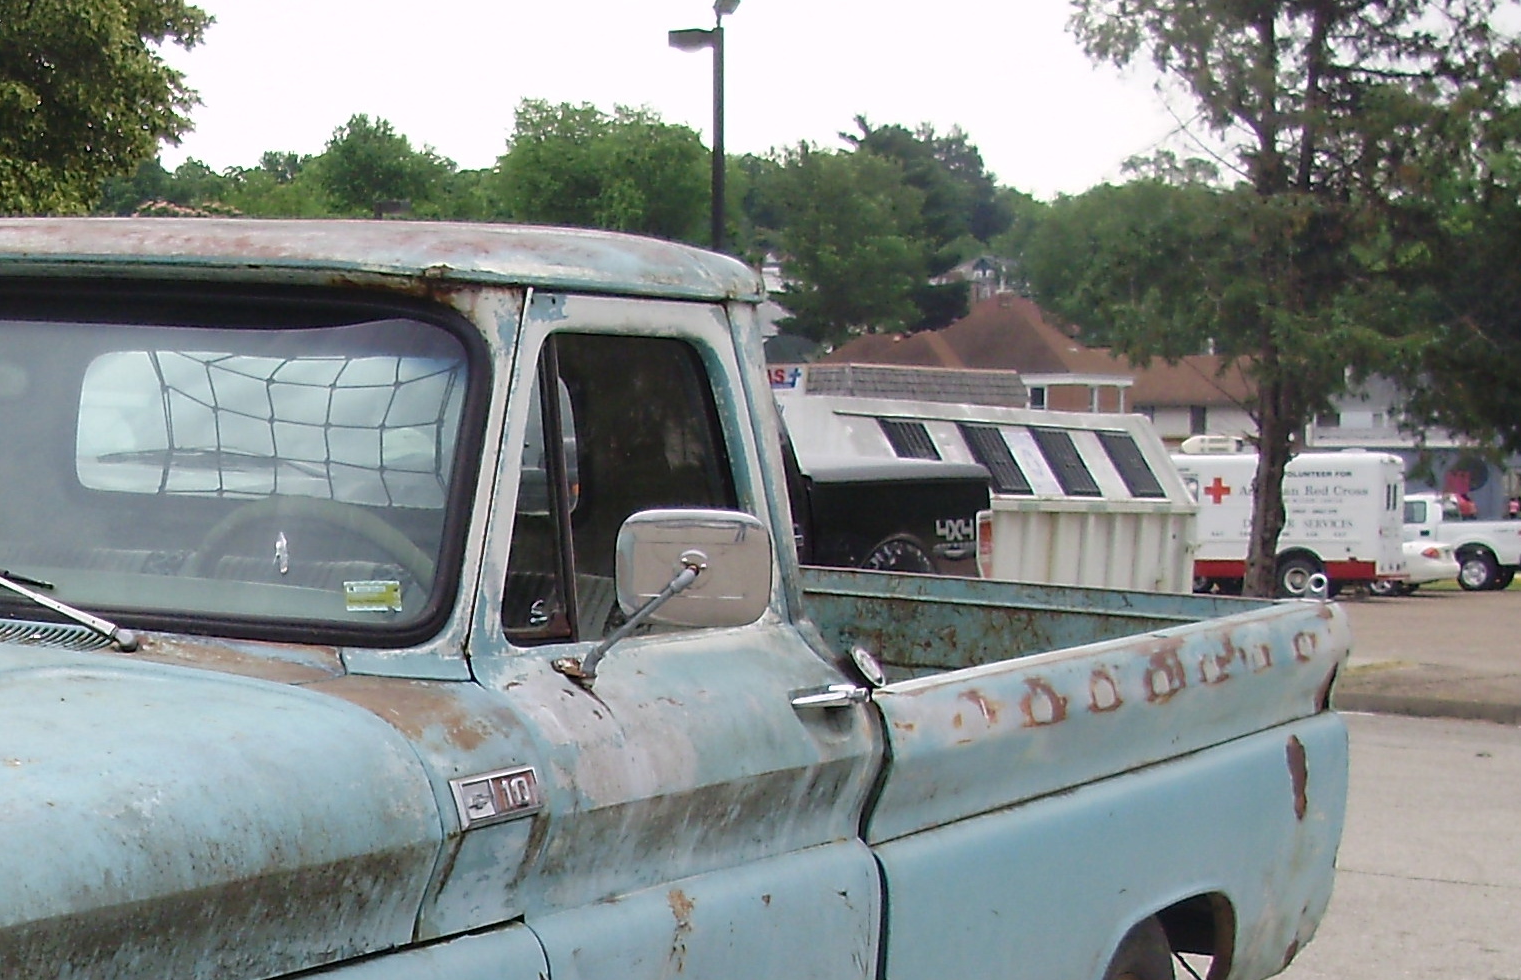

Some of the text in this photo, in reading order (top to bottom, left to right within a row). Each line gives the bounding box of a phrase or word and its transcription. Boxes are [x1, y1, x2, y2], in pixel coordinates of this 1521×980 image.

[1305, 486, 1329, 496] Red
[1333, 486, 1368, 496] Cross
[1304, 519, 1354, 528] SERVICES
[500, 776, 530, 808] 10
